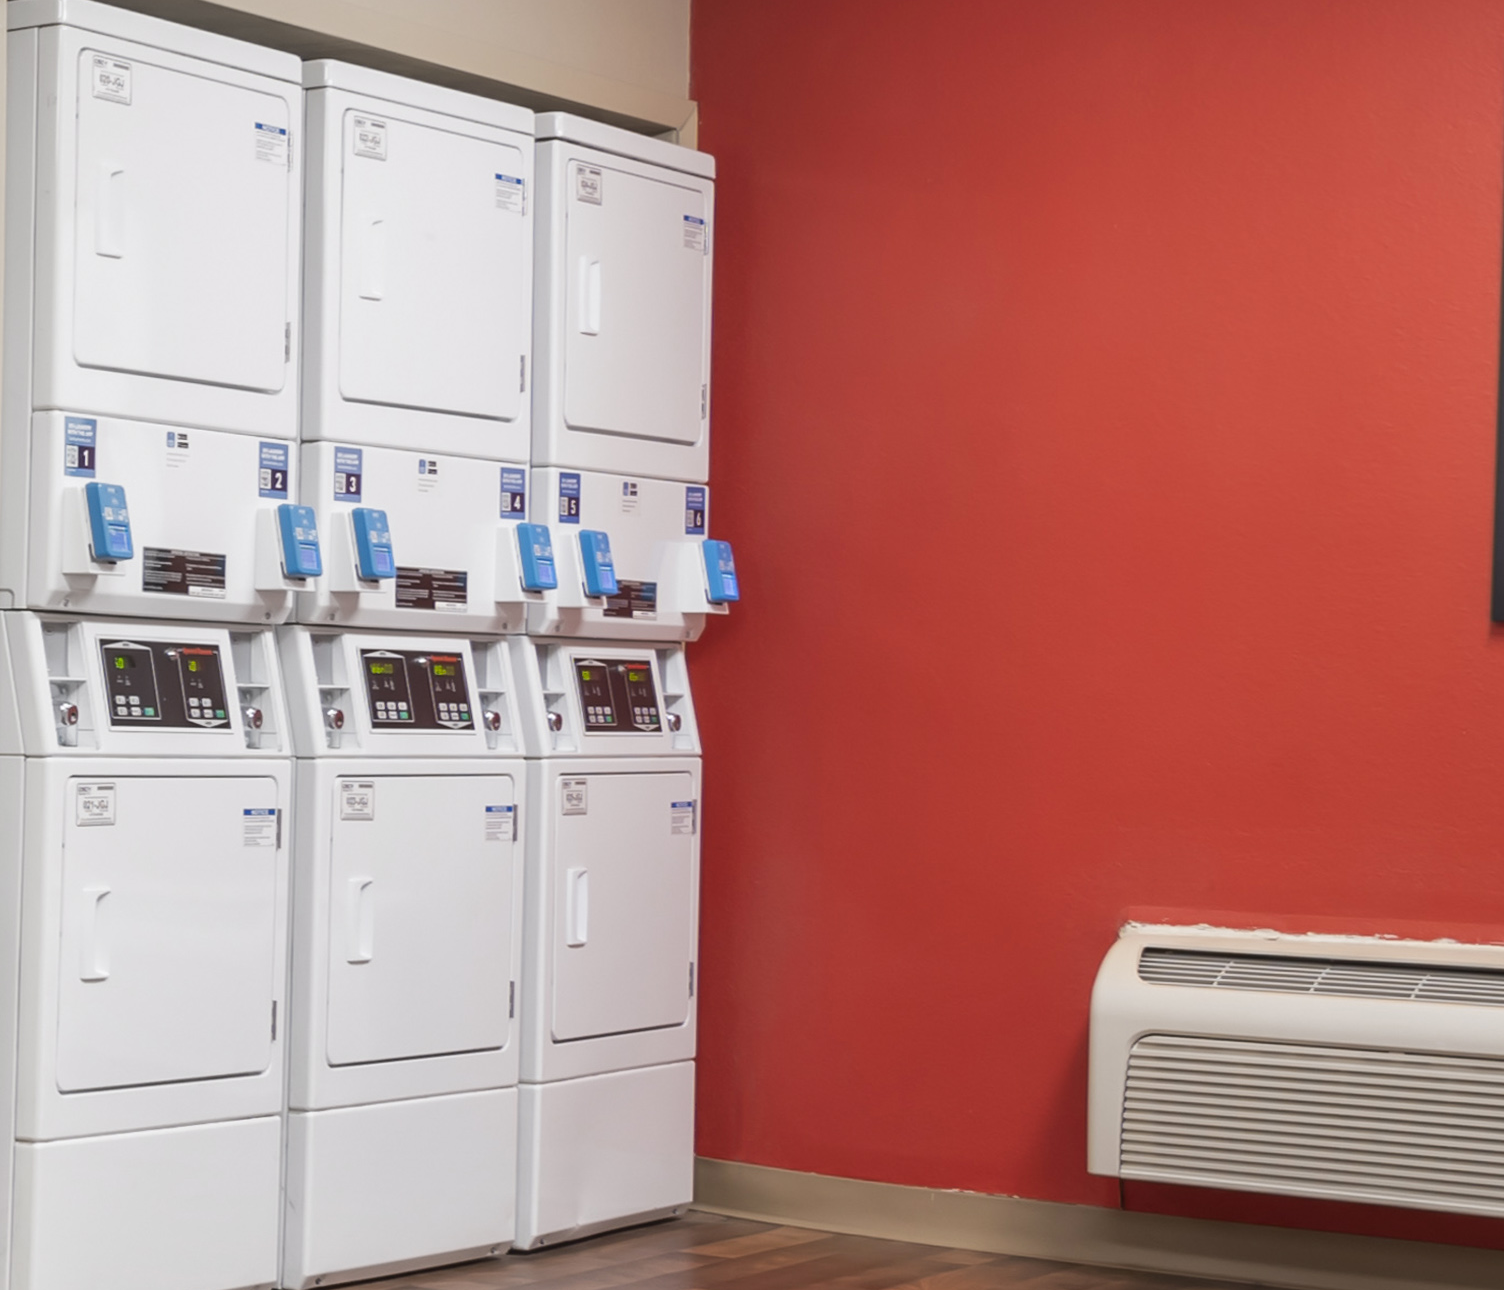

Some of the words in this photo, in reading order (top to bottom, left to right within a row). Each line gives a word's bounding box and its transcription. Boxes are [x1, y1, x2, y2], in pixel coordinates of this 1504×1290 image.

[82, 448, 90, 467] 1
[274, 471, 284, 489] 2
[349, 476, 357, 493] 3
[513, 495, 522, 510] 4
[569, 499, 577, 515] 5
[695, 512, 702, 526] 6
